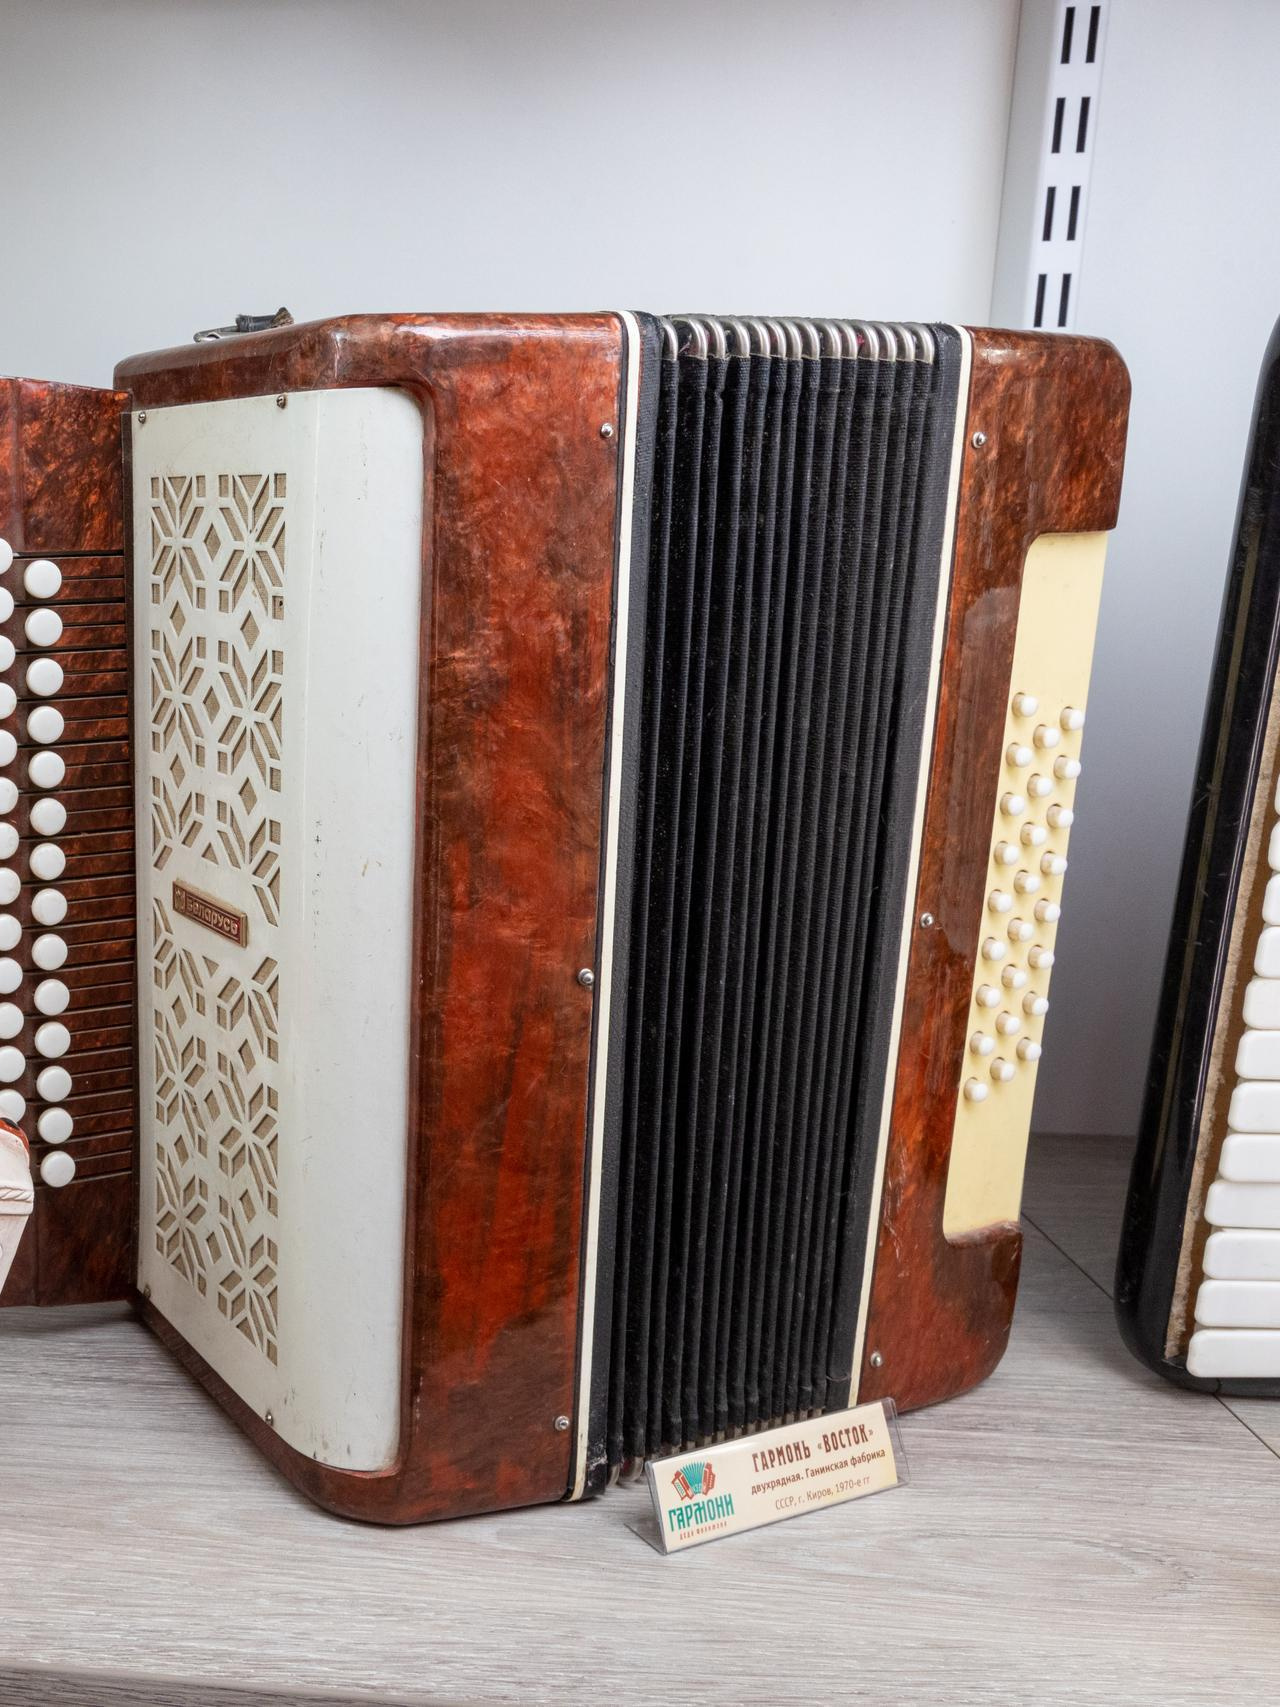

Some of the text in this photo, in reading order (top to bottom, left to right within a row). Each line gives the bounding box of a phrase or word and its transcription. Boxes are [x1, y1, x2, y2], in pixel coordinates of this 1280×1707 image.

[186, 896, 239, 936] Беларусь
[751, 1423, 874, 1473] ГАРМОНЬ «ВОСТОК»
[751, 1449, 886, 1496] двухрядная. Ганинская фабрика
[667, 1493, 735, 1533] ГАРМОНИ
[775, 1496, 797, 1511] СССР,
[806, 1488, 834, 1503] Киров,
[835, 1479, 862, 1494] 1970-е
